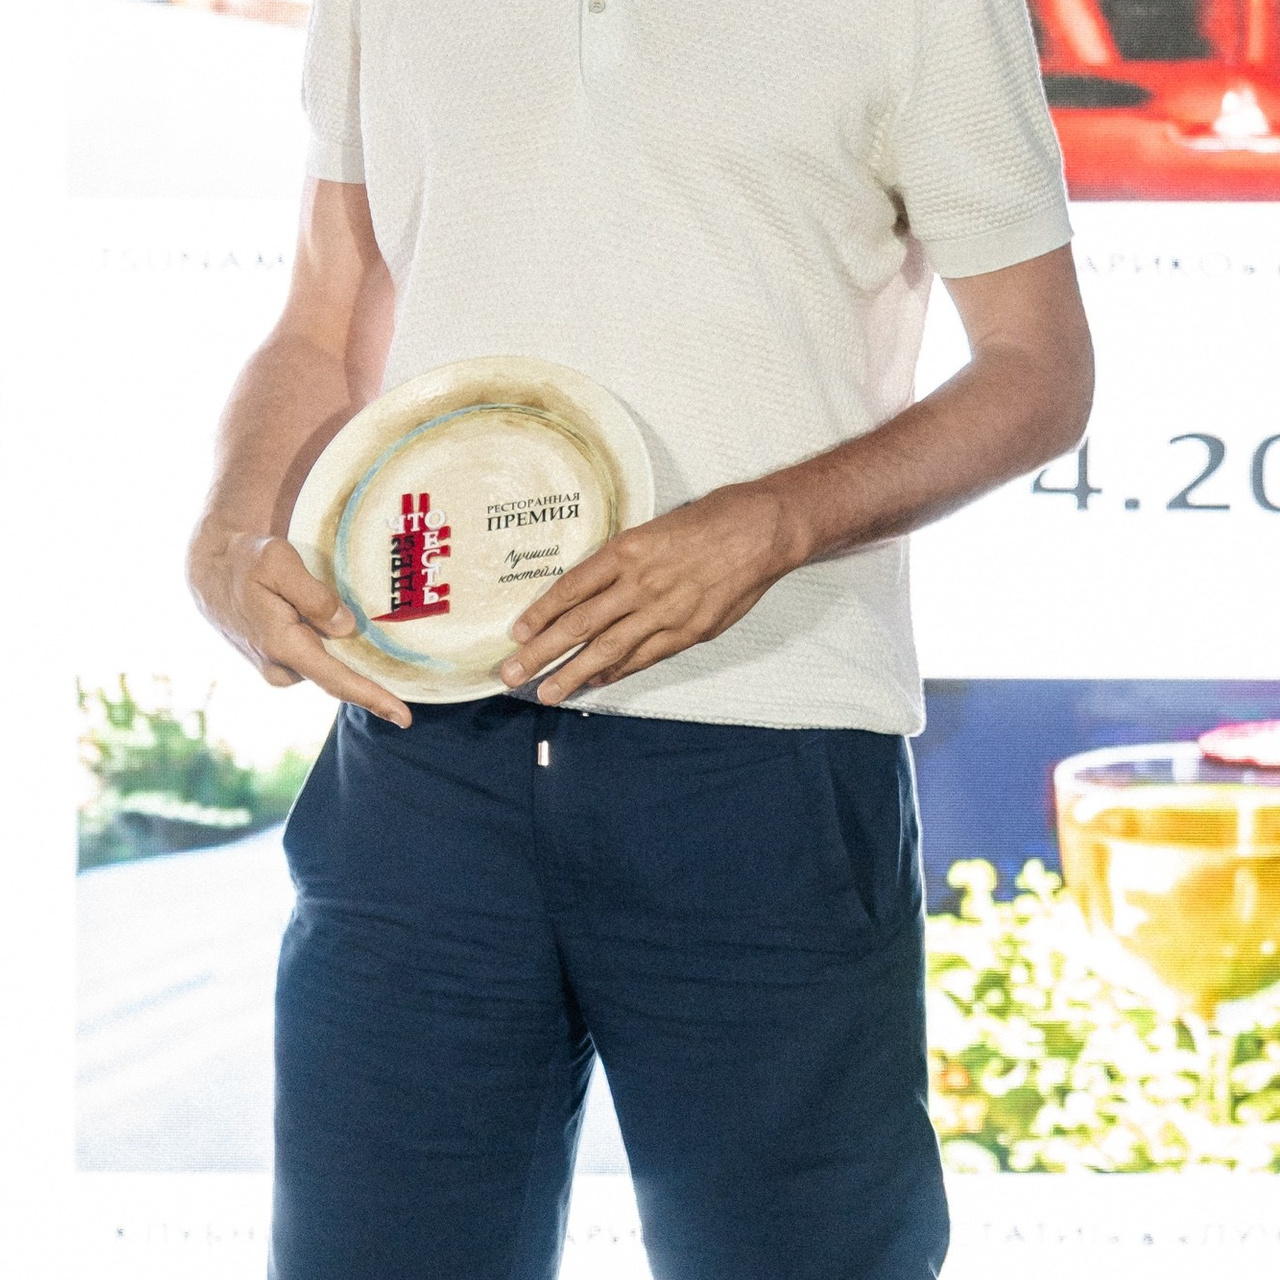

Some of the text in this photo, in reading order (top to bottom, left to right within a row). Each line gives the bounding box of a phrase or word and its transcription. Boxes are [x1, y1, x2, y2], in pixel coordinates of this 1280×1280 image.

[486, 492, 580, 514] РЕСТОРАННАЯ
[388, 509, 445, 534] ЧТО
[486, 504, 580, 532] ПРЕМИЯ
[504, 544, 560, 569] Лучший
[498, 565, 564, 584] коктейль
